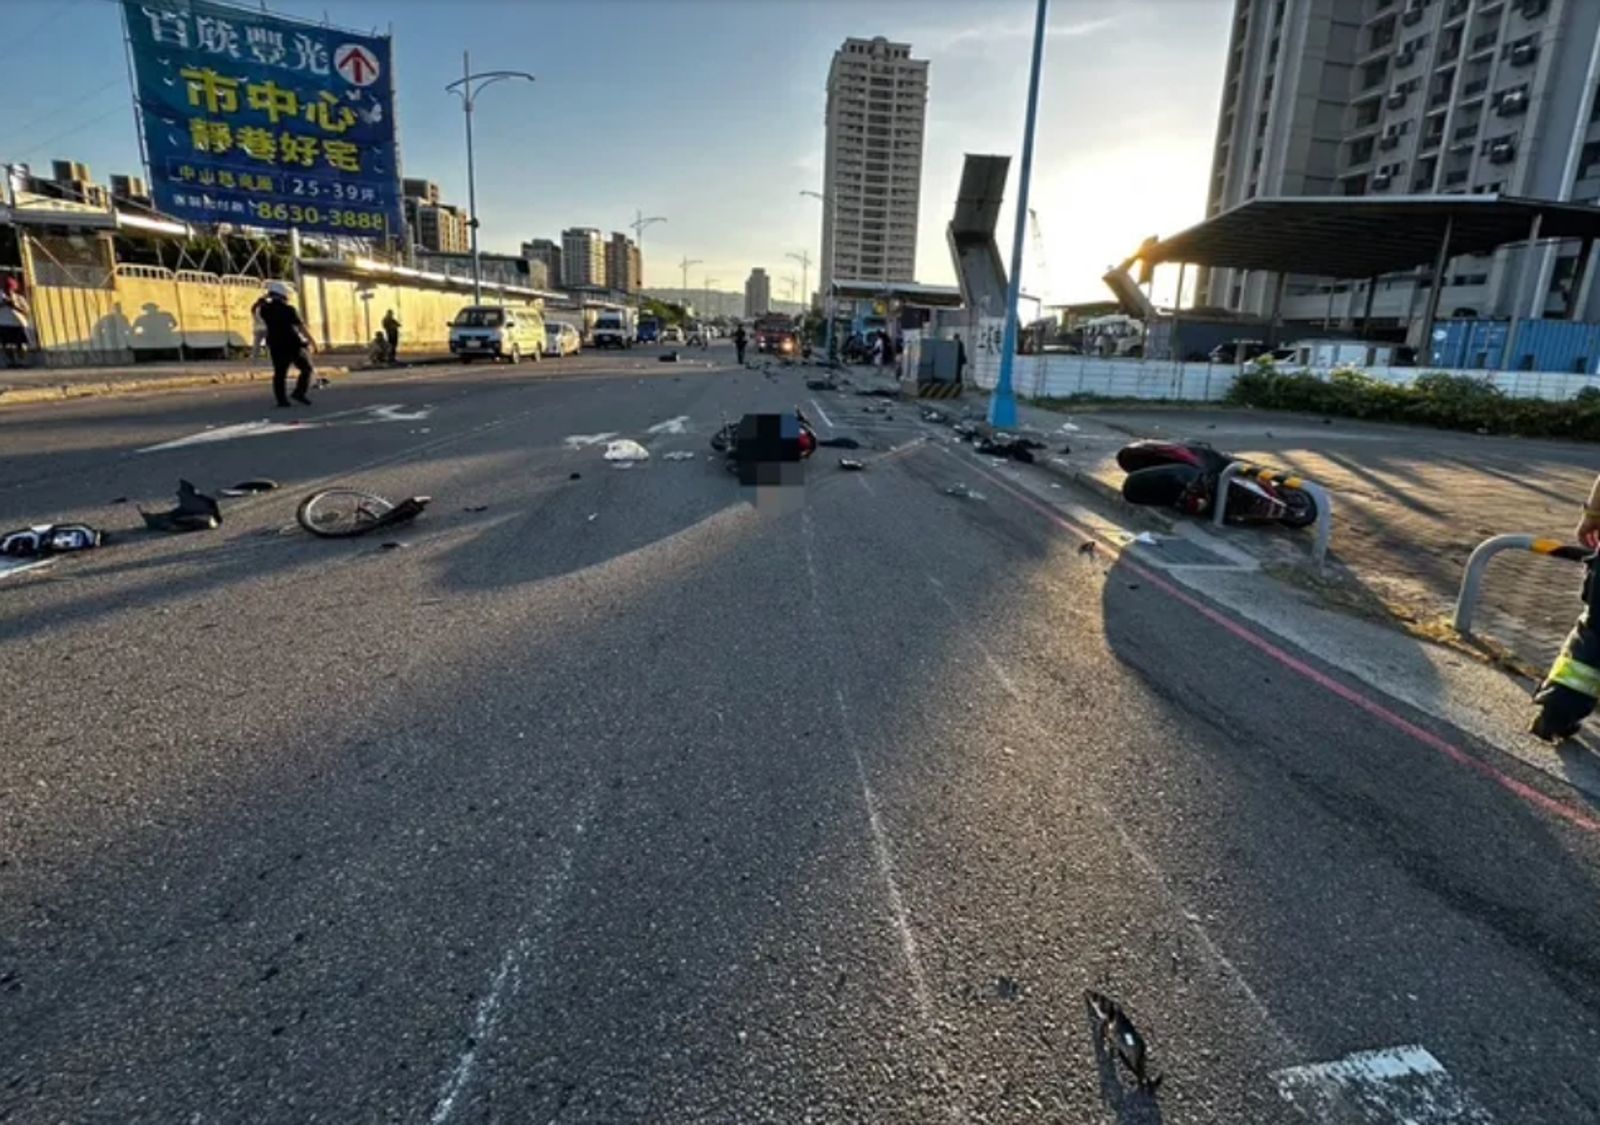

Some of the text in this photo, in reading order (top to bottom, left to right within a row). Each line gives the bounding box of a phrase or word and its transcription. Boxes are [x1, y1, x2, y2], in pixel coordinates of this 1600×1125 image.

[179, 67, 358, 133] 市中心
[189, 118, 361, 173] 靜巷好宅
[257, 201, 384, 230] 8630-3888
